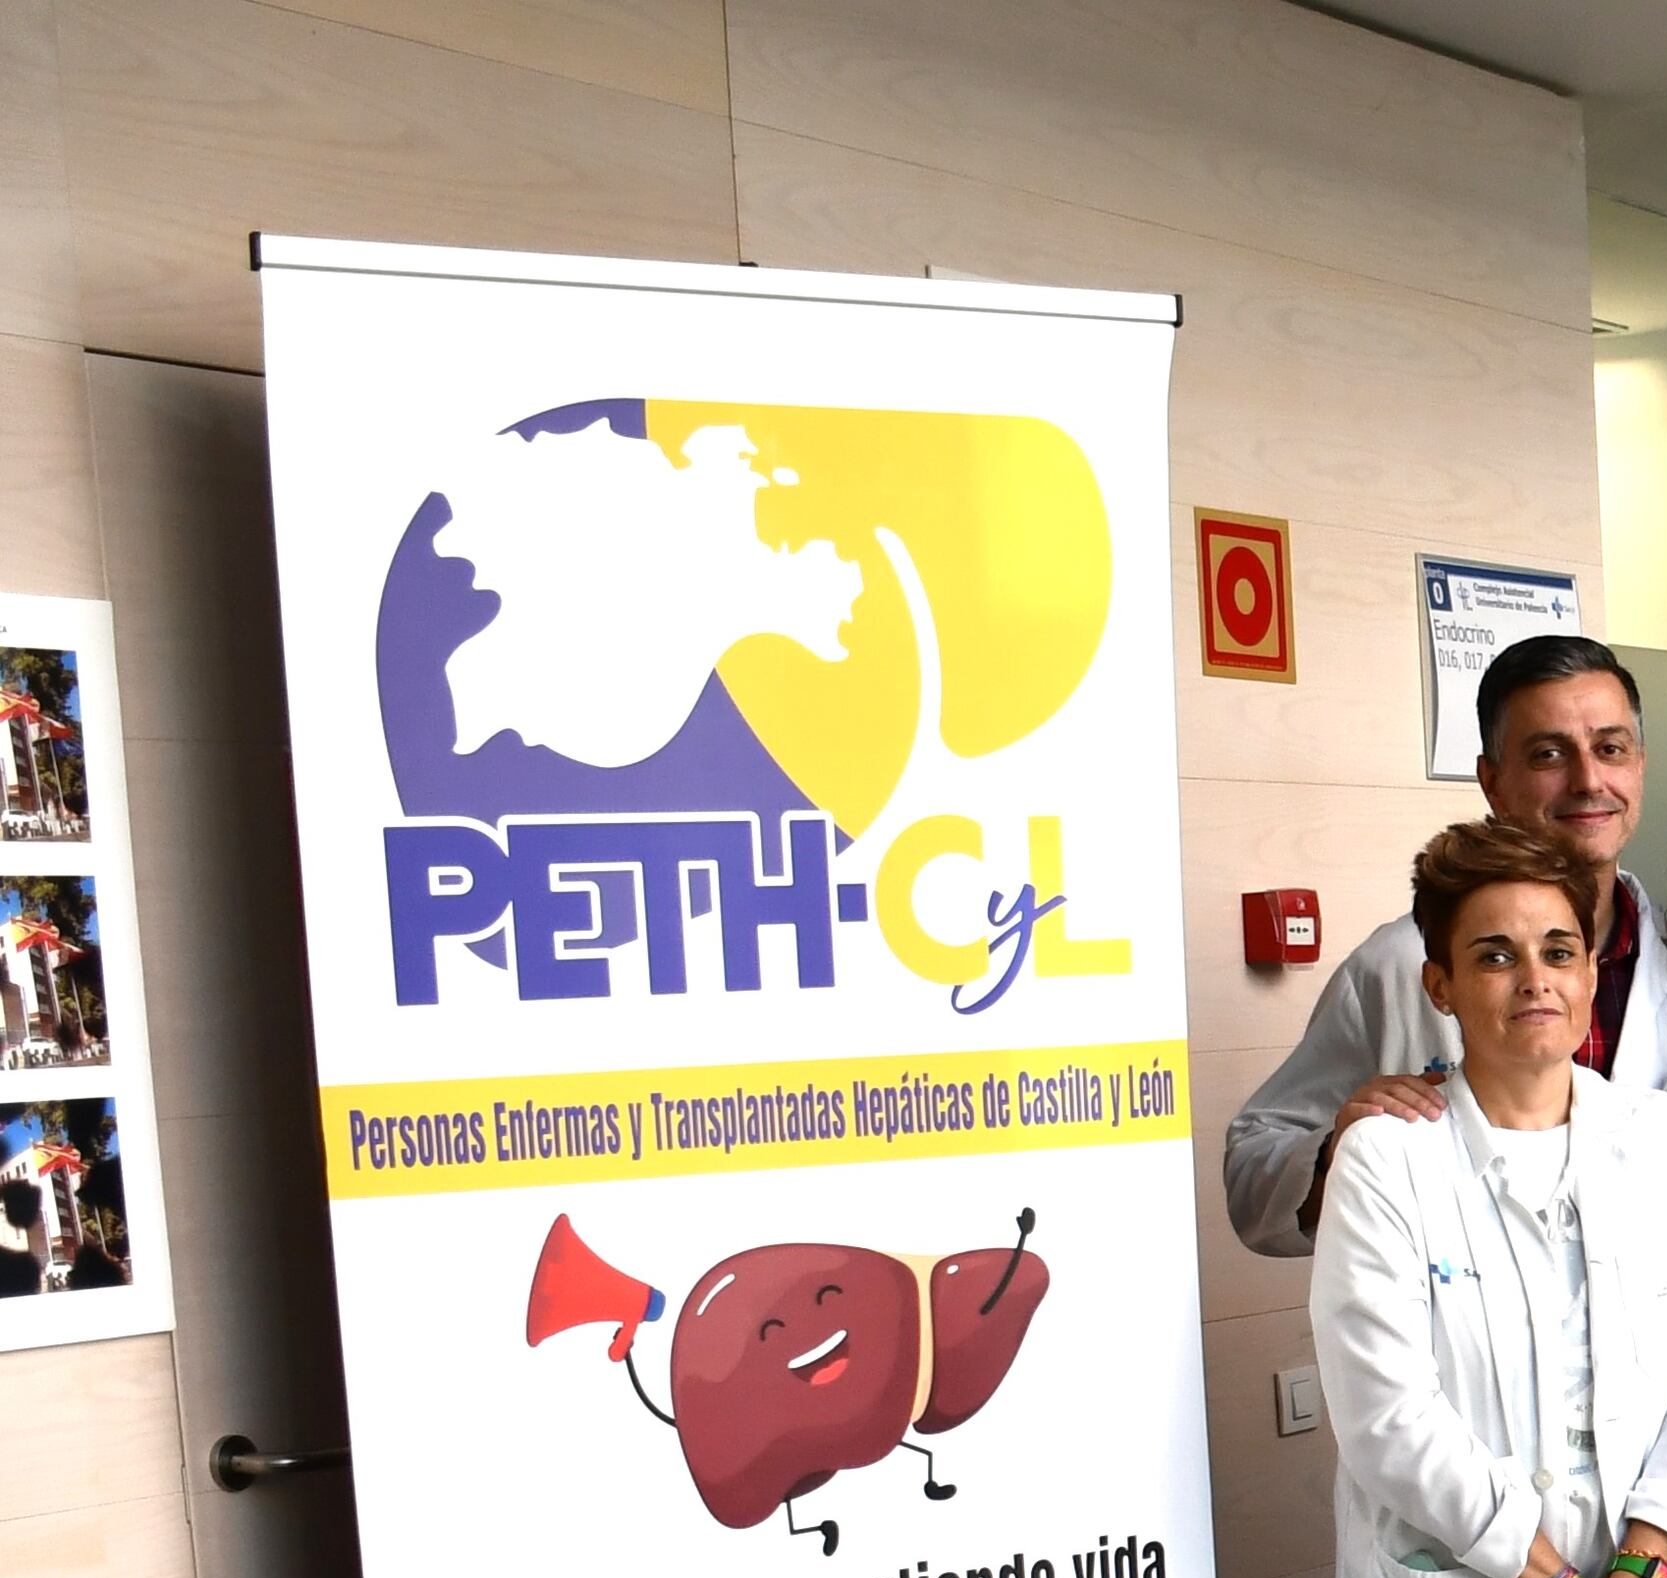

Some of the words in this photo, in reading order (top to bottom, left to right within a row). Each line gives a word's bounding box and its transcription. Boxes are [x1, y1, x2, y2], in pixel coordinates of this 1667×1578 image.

[1432, 581, 1445, 605] 0
[1432, 618, 1496, 646] Endocrino
[383, 814, 1133, 1015] PETH-CyL
[348, 1108, 487, 1171] Personas
[493, 1099, 622, 1162] Enfermas
[627, 1102, 643, 1161] y
[650, 1083, 846, 1154] Transplantadas
[852, 1071, 975, 1142] Hepáticas
[982, 1074, 1011, 1129] de
[1018, 1064, 1103, 1125] Castilla
[1109, 1073, 1122, 1128] y
[1128, 1057, 1175, 1120] León
